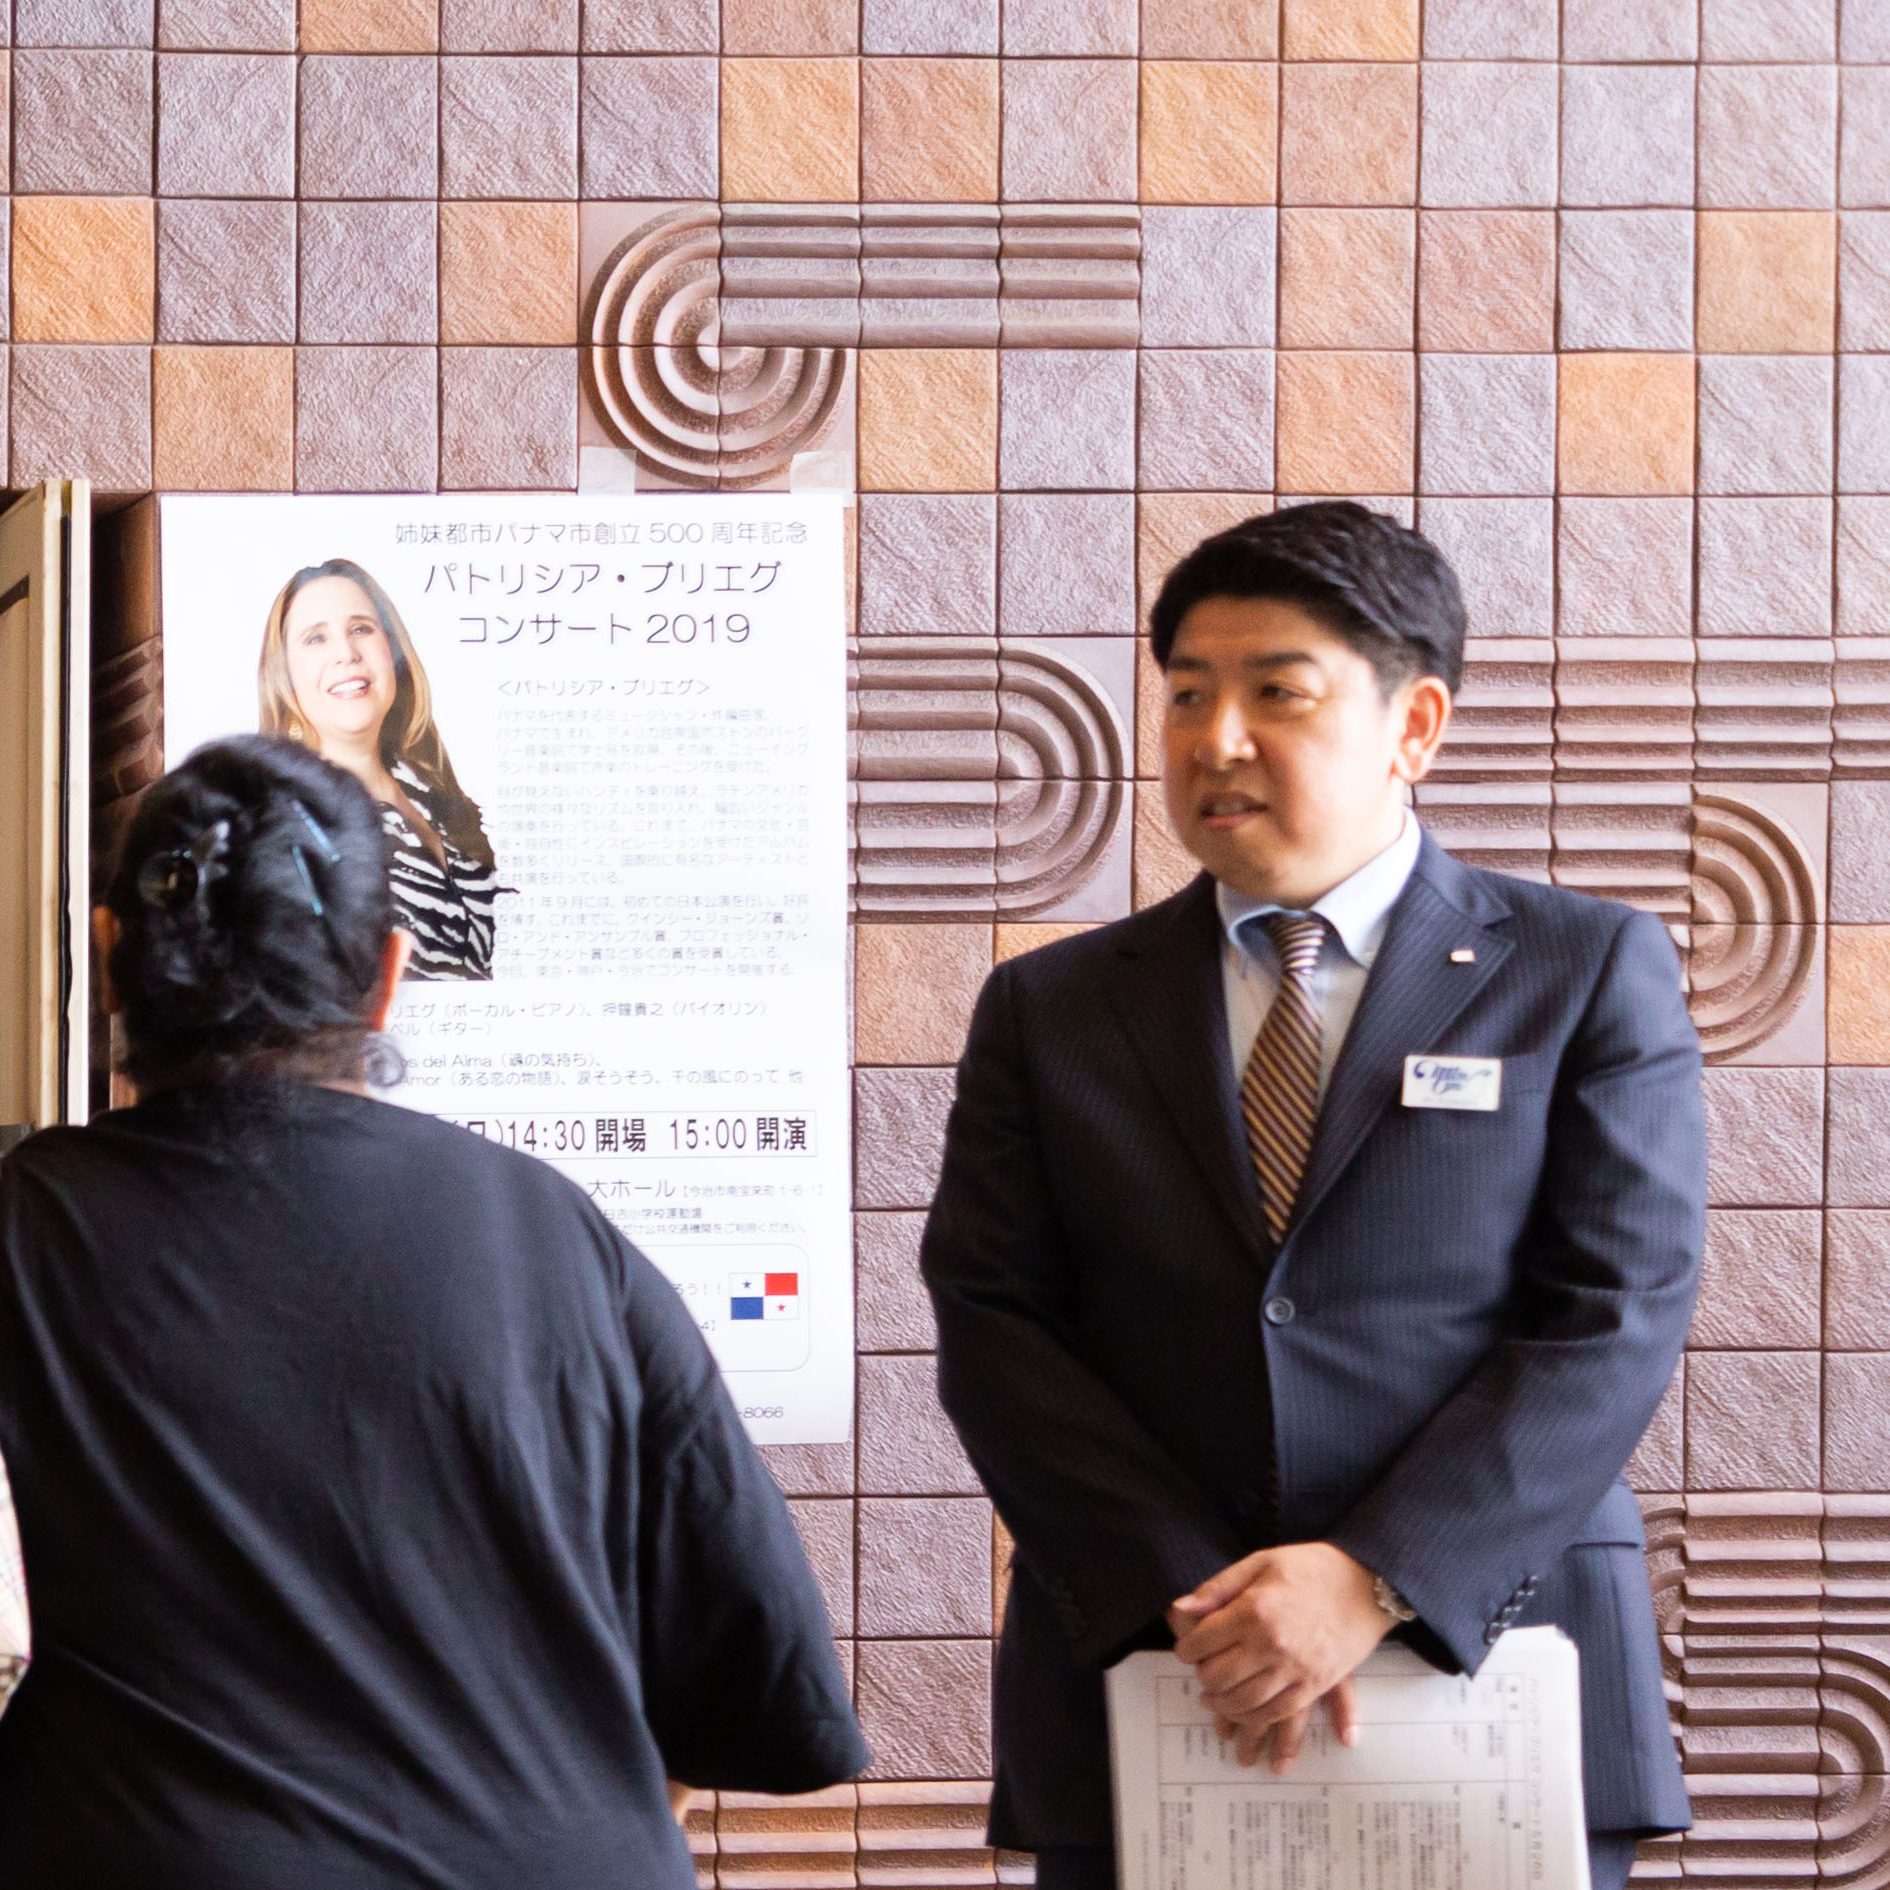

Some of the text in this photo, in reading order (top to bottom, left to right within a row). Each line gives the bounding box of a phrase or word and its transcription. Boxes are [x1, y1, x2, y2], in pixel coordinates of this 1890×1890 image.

[423, 560, 783, 595] パトリシア・ブリエグ
[458, 612, 751, 645] コンサート 2019
